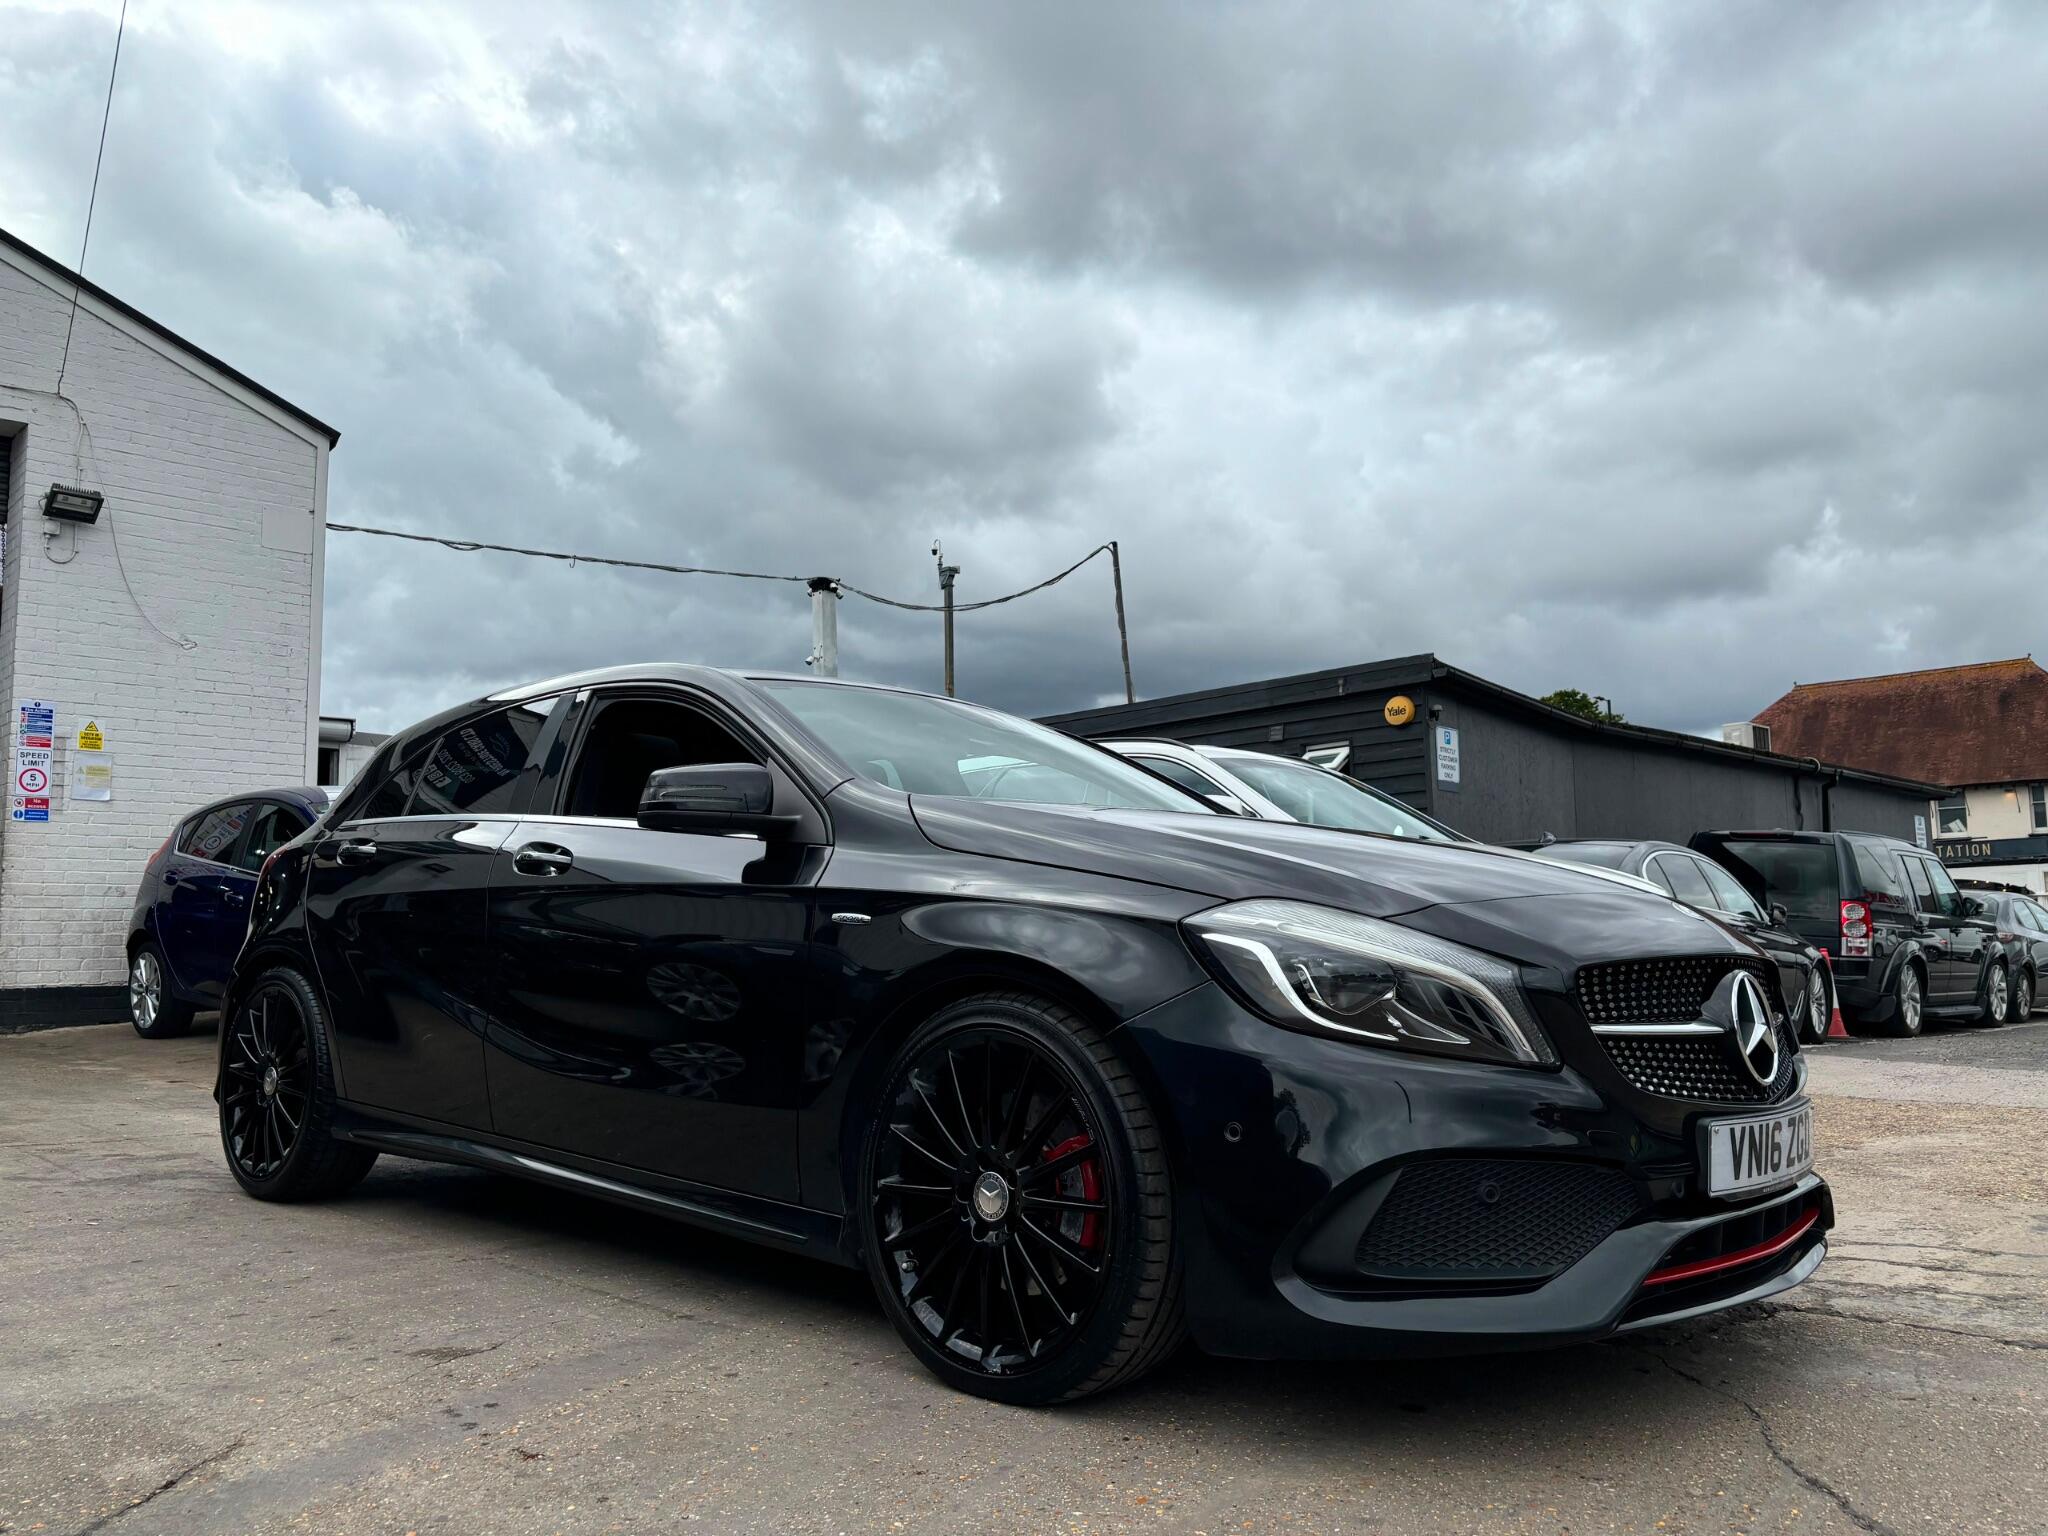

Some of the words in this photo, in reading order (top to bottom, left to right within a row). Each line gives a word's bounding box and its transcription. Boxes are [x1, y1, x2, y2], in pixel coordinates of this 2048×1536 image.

[1387, 705, 1407, 717] Yale
[20, 751, 49, 760] SPEED
[1438, 754, 1458, 763] CUSTOMER
[1440, 762, 1457, 771] PARKING
[30, 773, 37, 782] 5
[1444, 771, 1454, 779] ONLY
[1936, 843, 1991, 858] TATION
[1730, 1121, 1783, 1181] VN16
